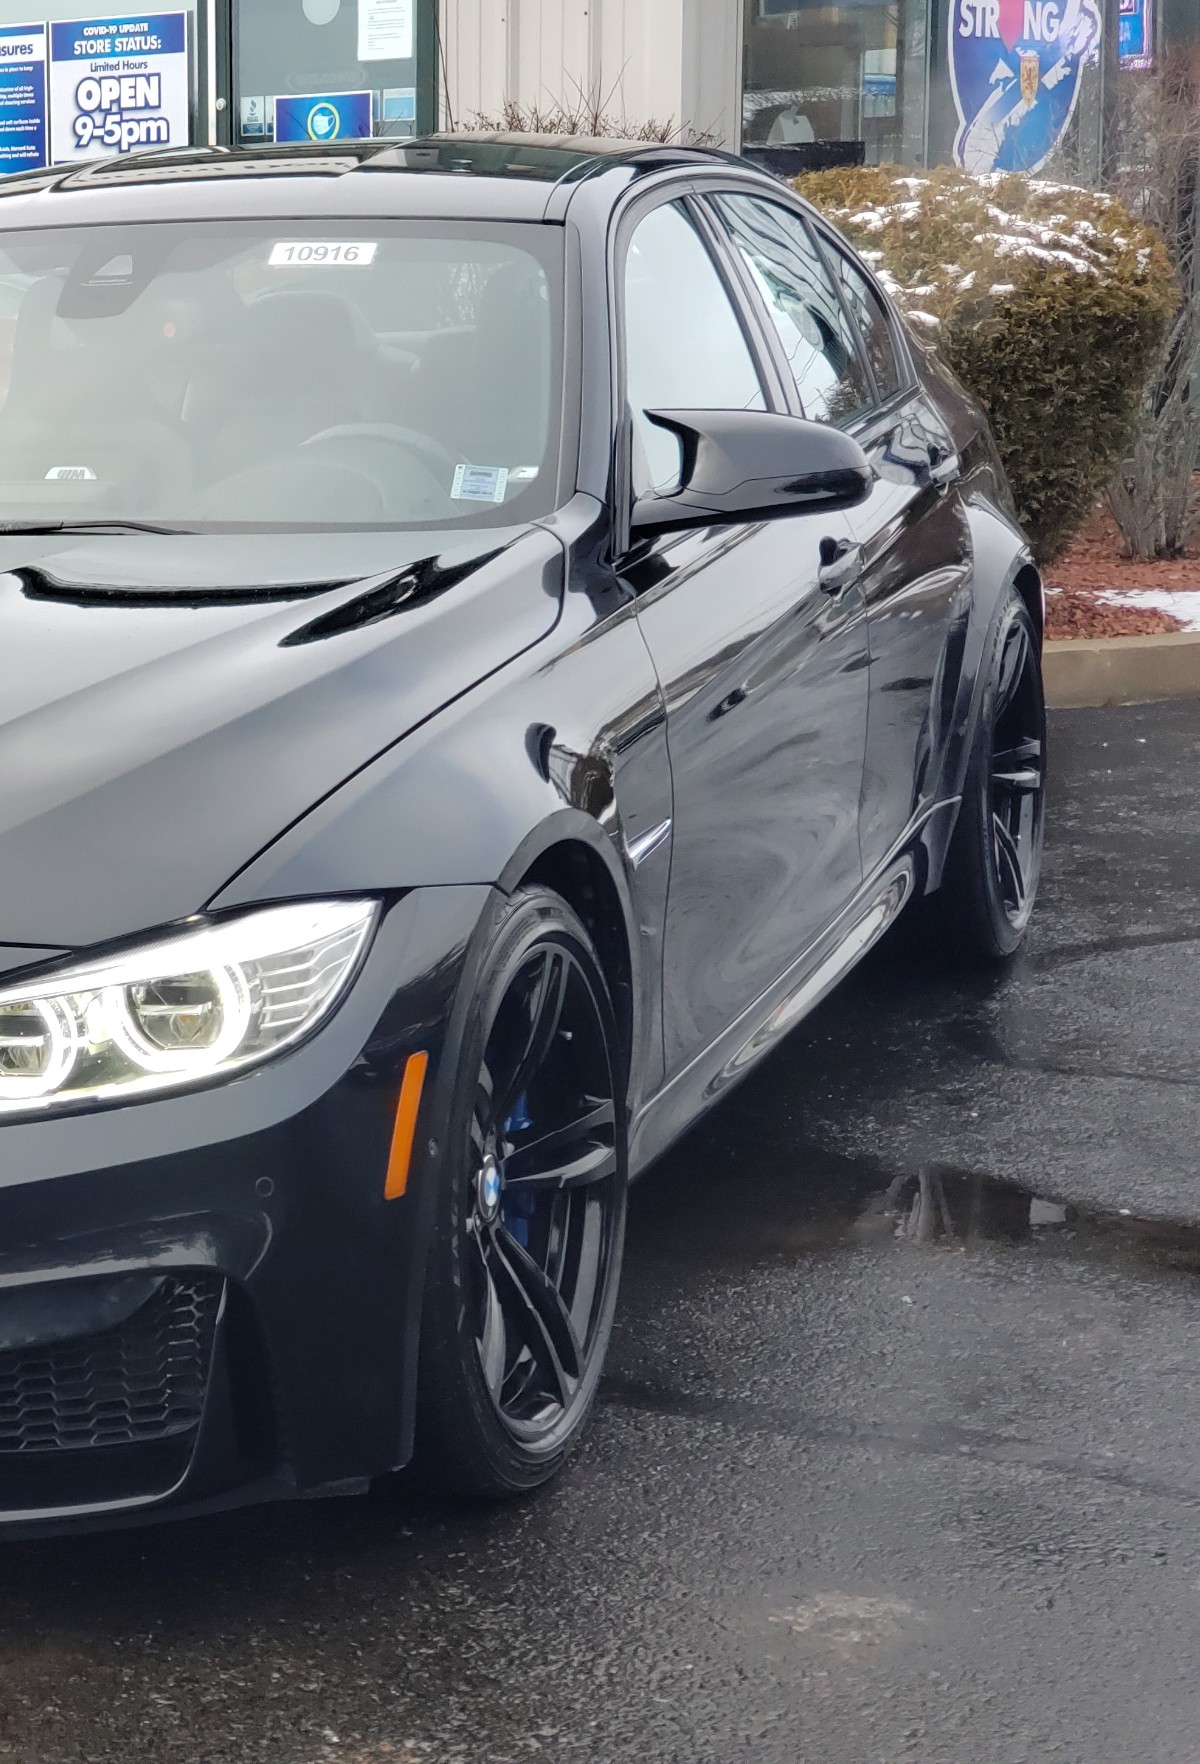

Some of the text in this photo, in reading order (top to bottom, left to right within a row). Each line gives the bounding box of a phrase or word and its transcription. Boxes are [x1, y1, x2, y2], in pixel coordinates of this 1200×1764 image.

[83, 22, 149, 36] COVID-19 UPDATE
[959, 0, 1060, 42] STRNG
[73, 35, 162, 55] STORE STATUS:
[90, 60, 148, 72] Limited Hours
[75, 72, 161, 114] OPEN
[73, 112, 170, 153] 9-5pm
[284, 245, 360, 261] 10916
